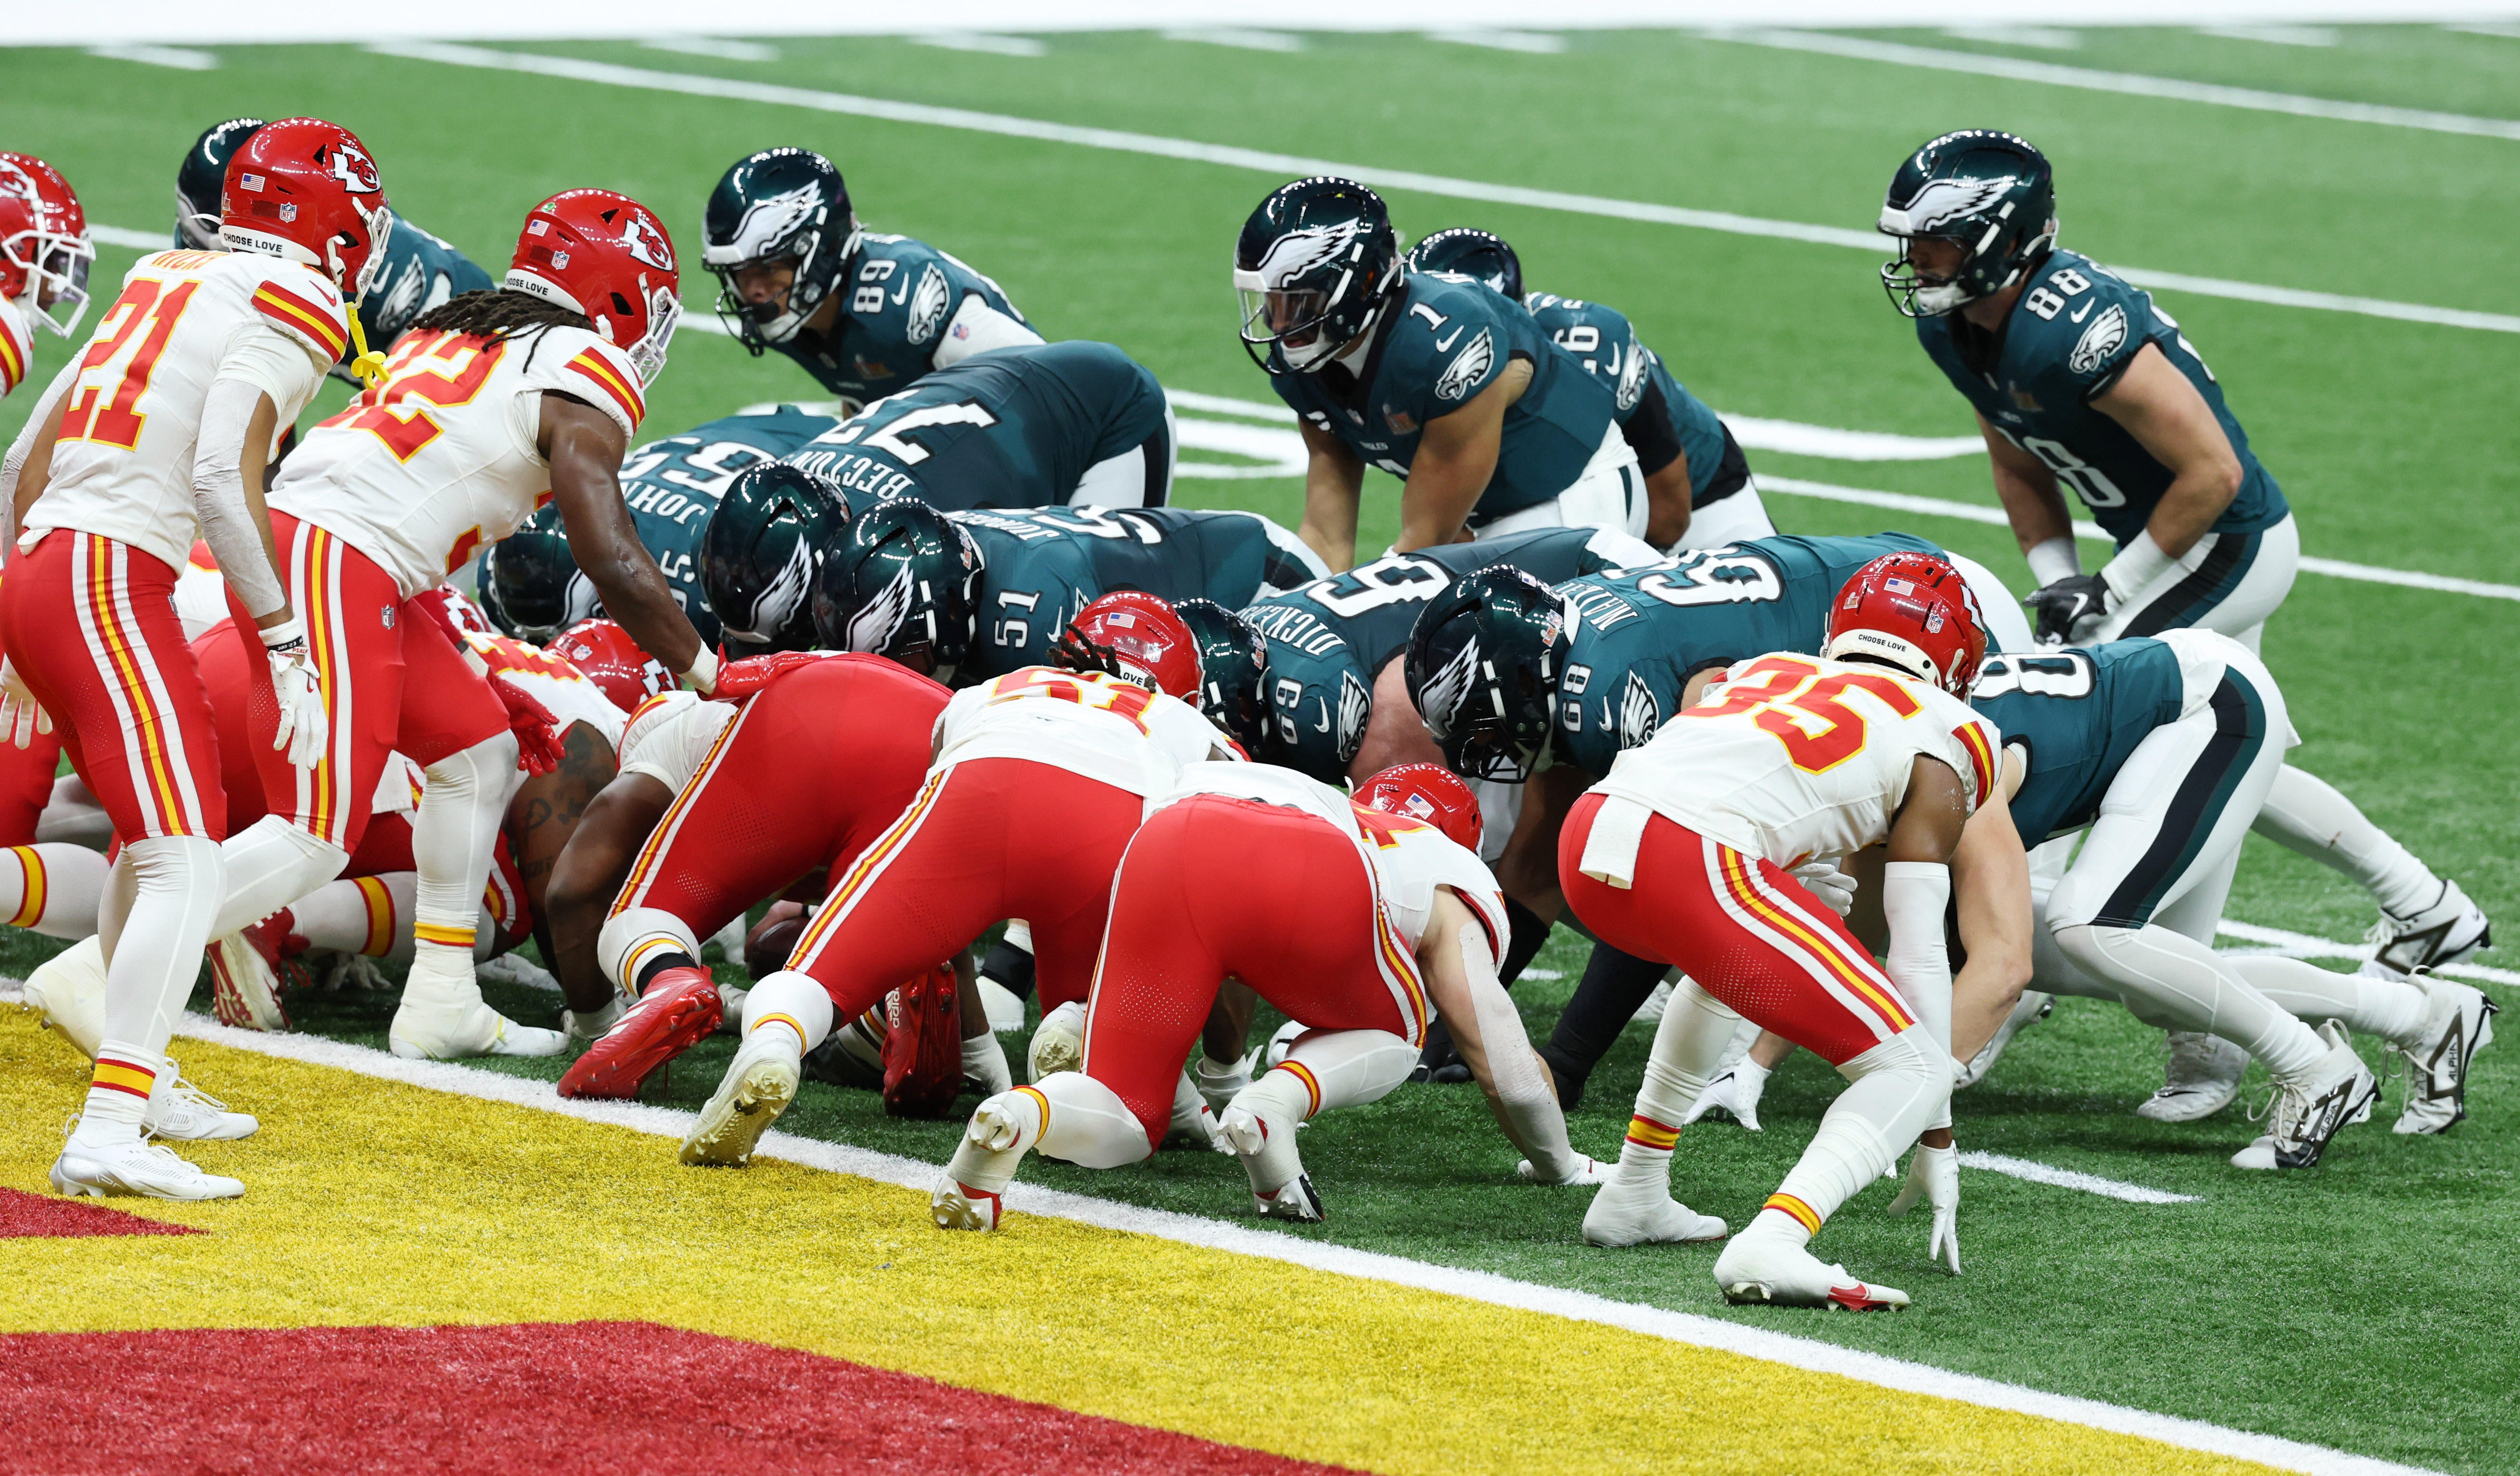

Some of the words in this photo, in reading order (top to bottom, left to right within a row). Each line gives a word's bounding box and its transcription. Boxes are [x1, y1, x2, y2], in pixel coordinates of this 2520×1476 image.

[282, 211, 294, 220] NFL
[224, 233, 253, 246] CHOOSE
[255, 240, 283, 252] LOVE
[553, 258, 565, 267] NFL
[525, 281, 549, 296] LOVE
[853, 260, 897, 313] 89
[2025, 268, 2092, 321] 88
[1410, 302, 1449, 331] 1
[56, 278, 203, 451] 21
[789, 450, 916, 501] BECTON
[994, 590, 1042, 648] 51
[1929, 619, 1940, 631] NFL
[1858, 634, 1886, 646] CHOOSE
[1887, 641, 1907, 652] LOVE
[1123, 672, 1144, 686] OVE
[1562, 663, 1592, 732] 68
[1275, 677, 1304, 745] 69
[1675, 656, 1924, 776] 35
[2448, 1042, 2458, 1082] ALPHA
[2320, 1104, 2340, 1139] ALPHA
